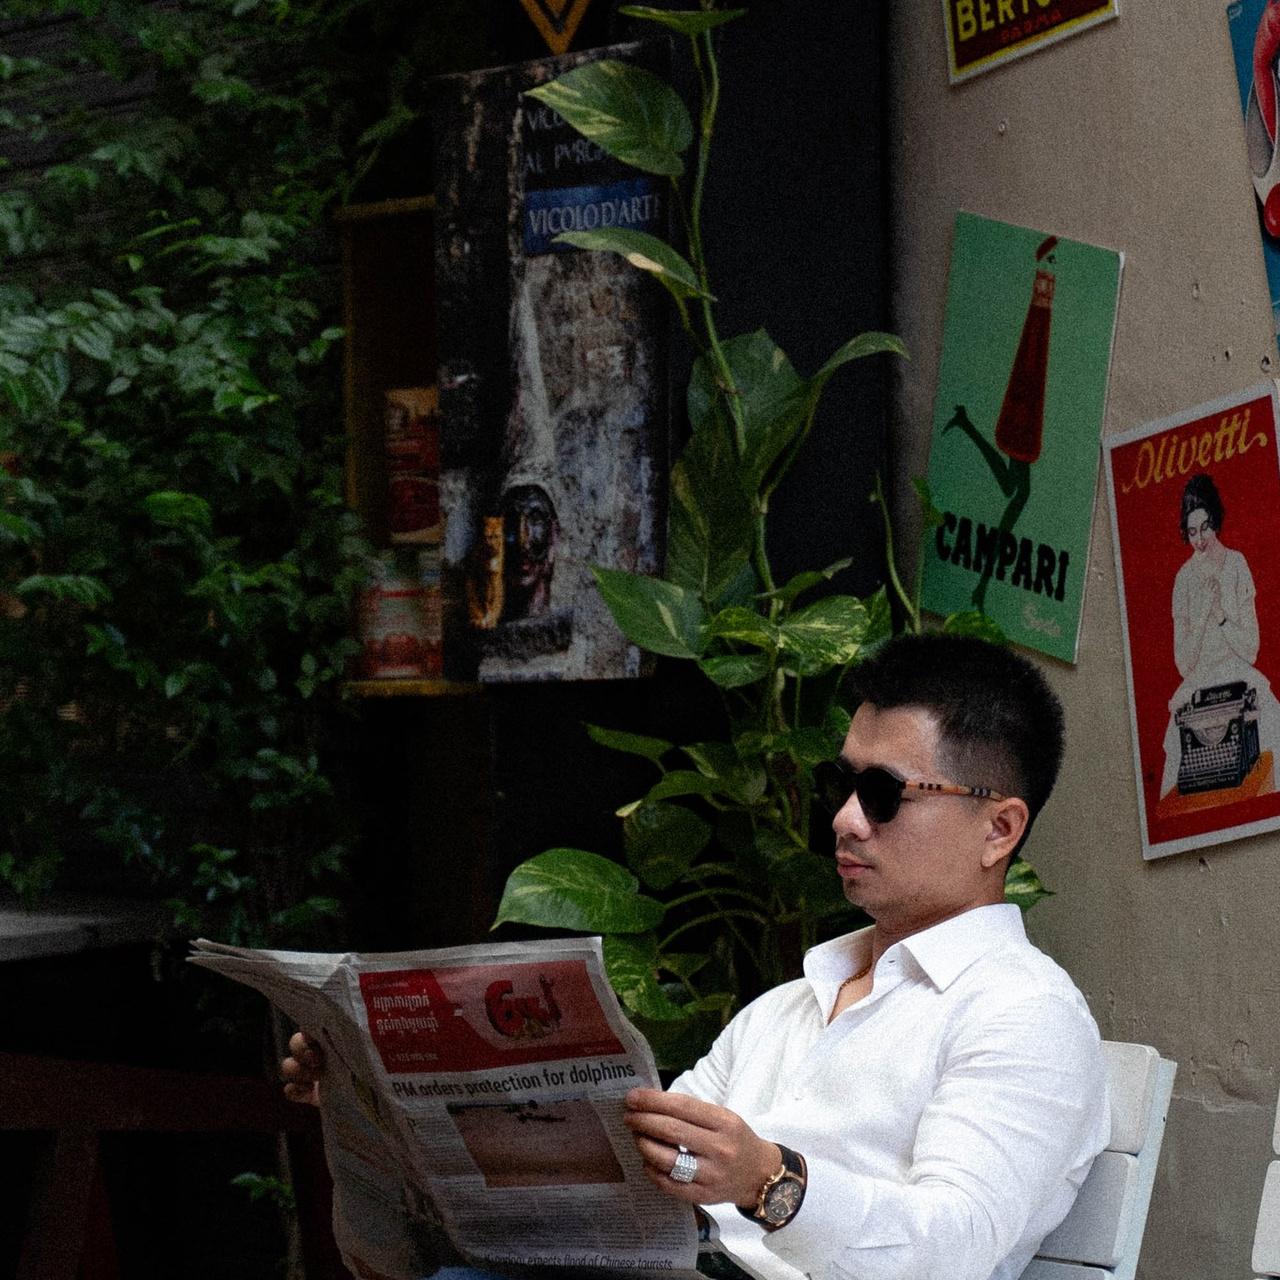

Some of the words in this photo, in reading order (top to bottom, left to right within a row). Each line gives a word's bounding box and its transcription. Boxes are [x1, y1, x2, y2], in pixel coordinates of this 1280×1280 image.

[528, 202, 600, 236] VICOLO
[1120, 408, 1270, 496] Olivetti
[934, 511, 1070, 602] CAMPARI
[392, 1081, 418, 1098] PM
[419, 1079, 463, 1097] orders
[465, 1073, 541, 1097] protection
[542, 1068, 567, 1087] for
[569, 1061, 637, 1086] dolphins
